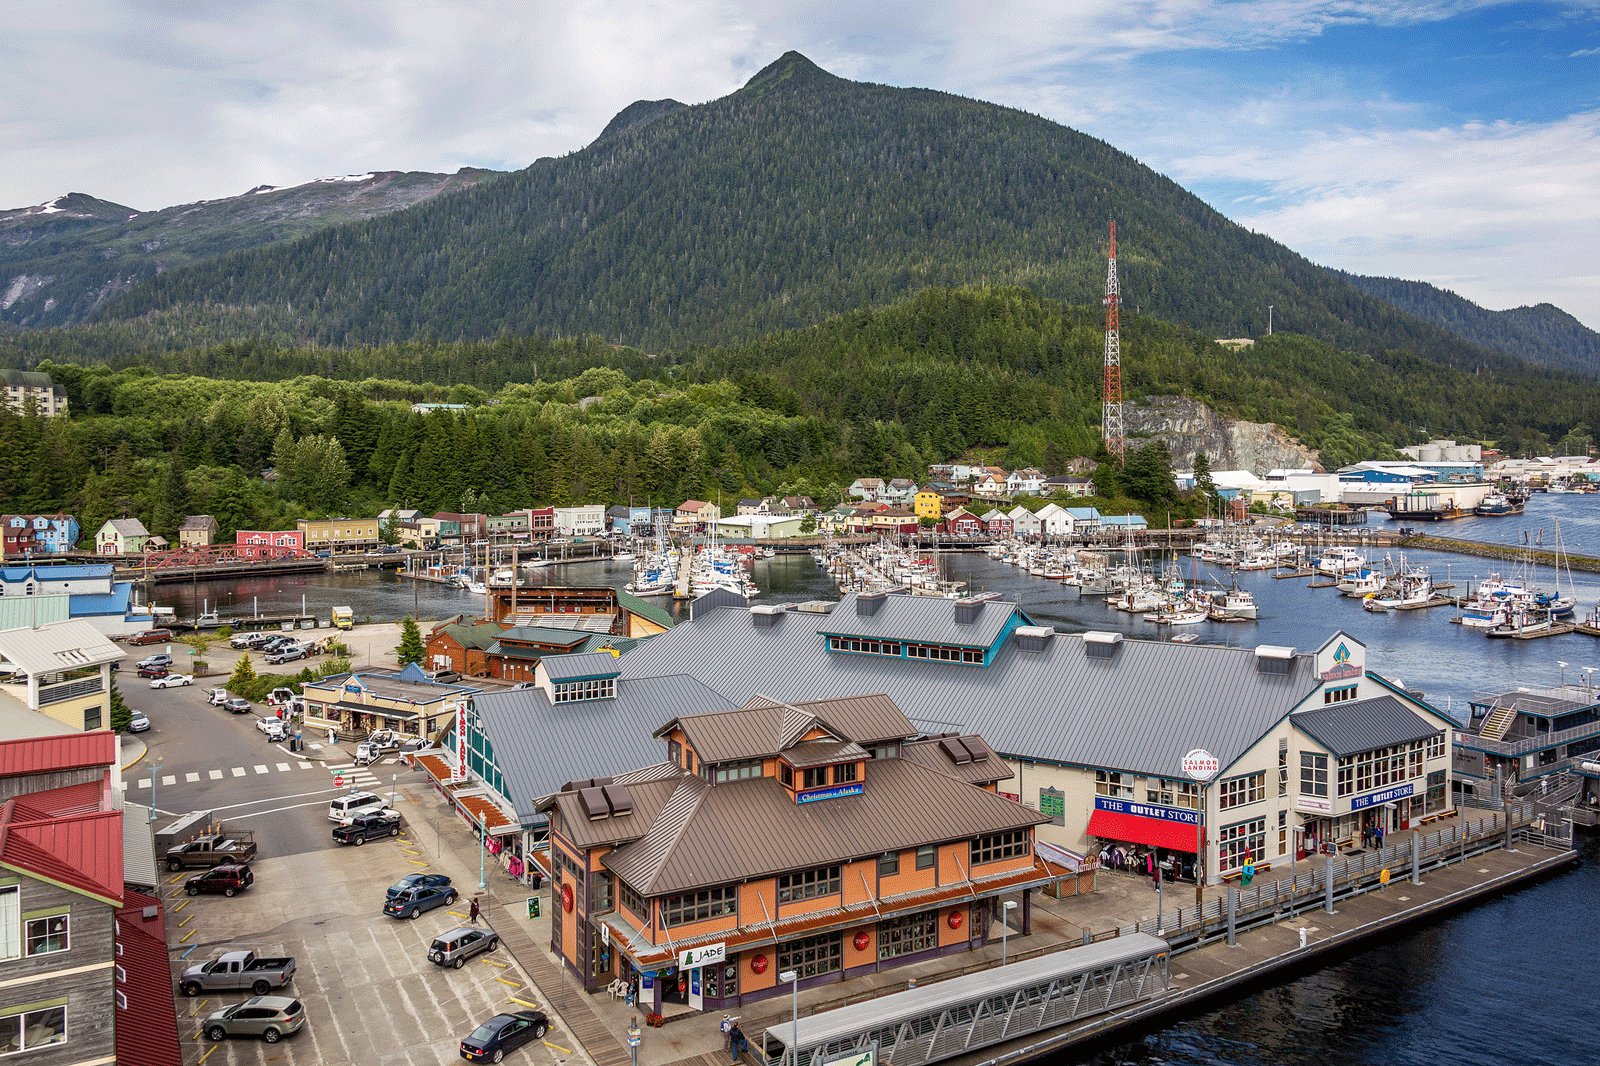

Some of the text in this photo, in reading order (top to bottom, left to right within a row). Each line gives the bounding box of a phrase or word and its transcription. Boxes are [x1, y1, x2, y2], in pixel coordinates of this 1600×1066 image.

[1354, 785, 1413, 808] THE OUTLET STORE
[1101, 799, 1124, 811] THE
[1130, 804, 1166, 818] OUTLET
[694, 946, 724, 963] JADE
